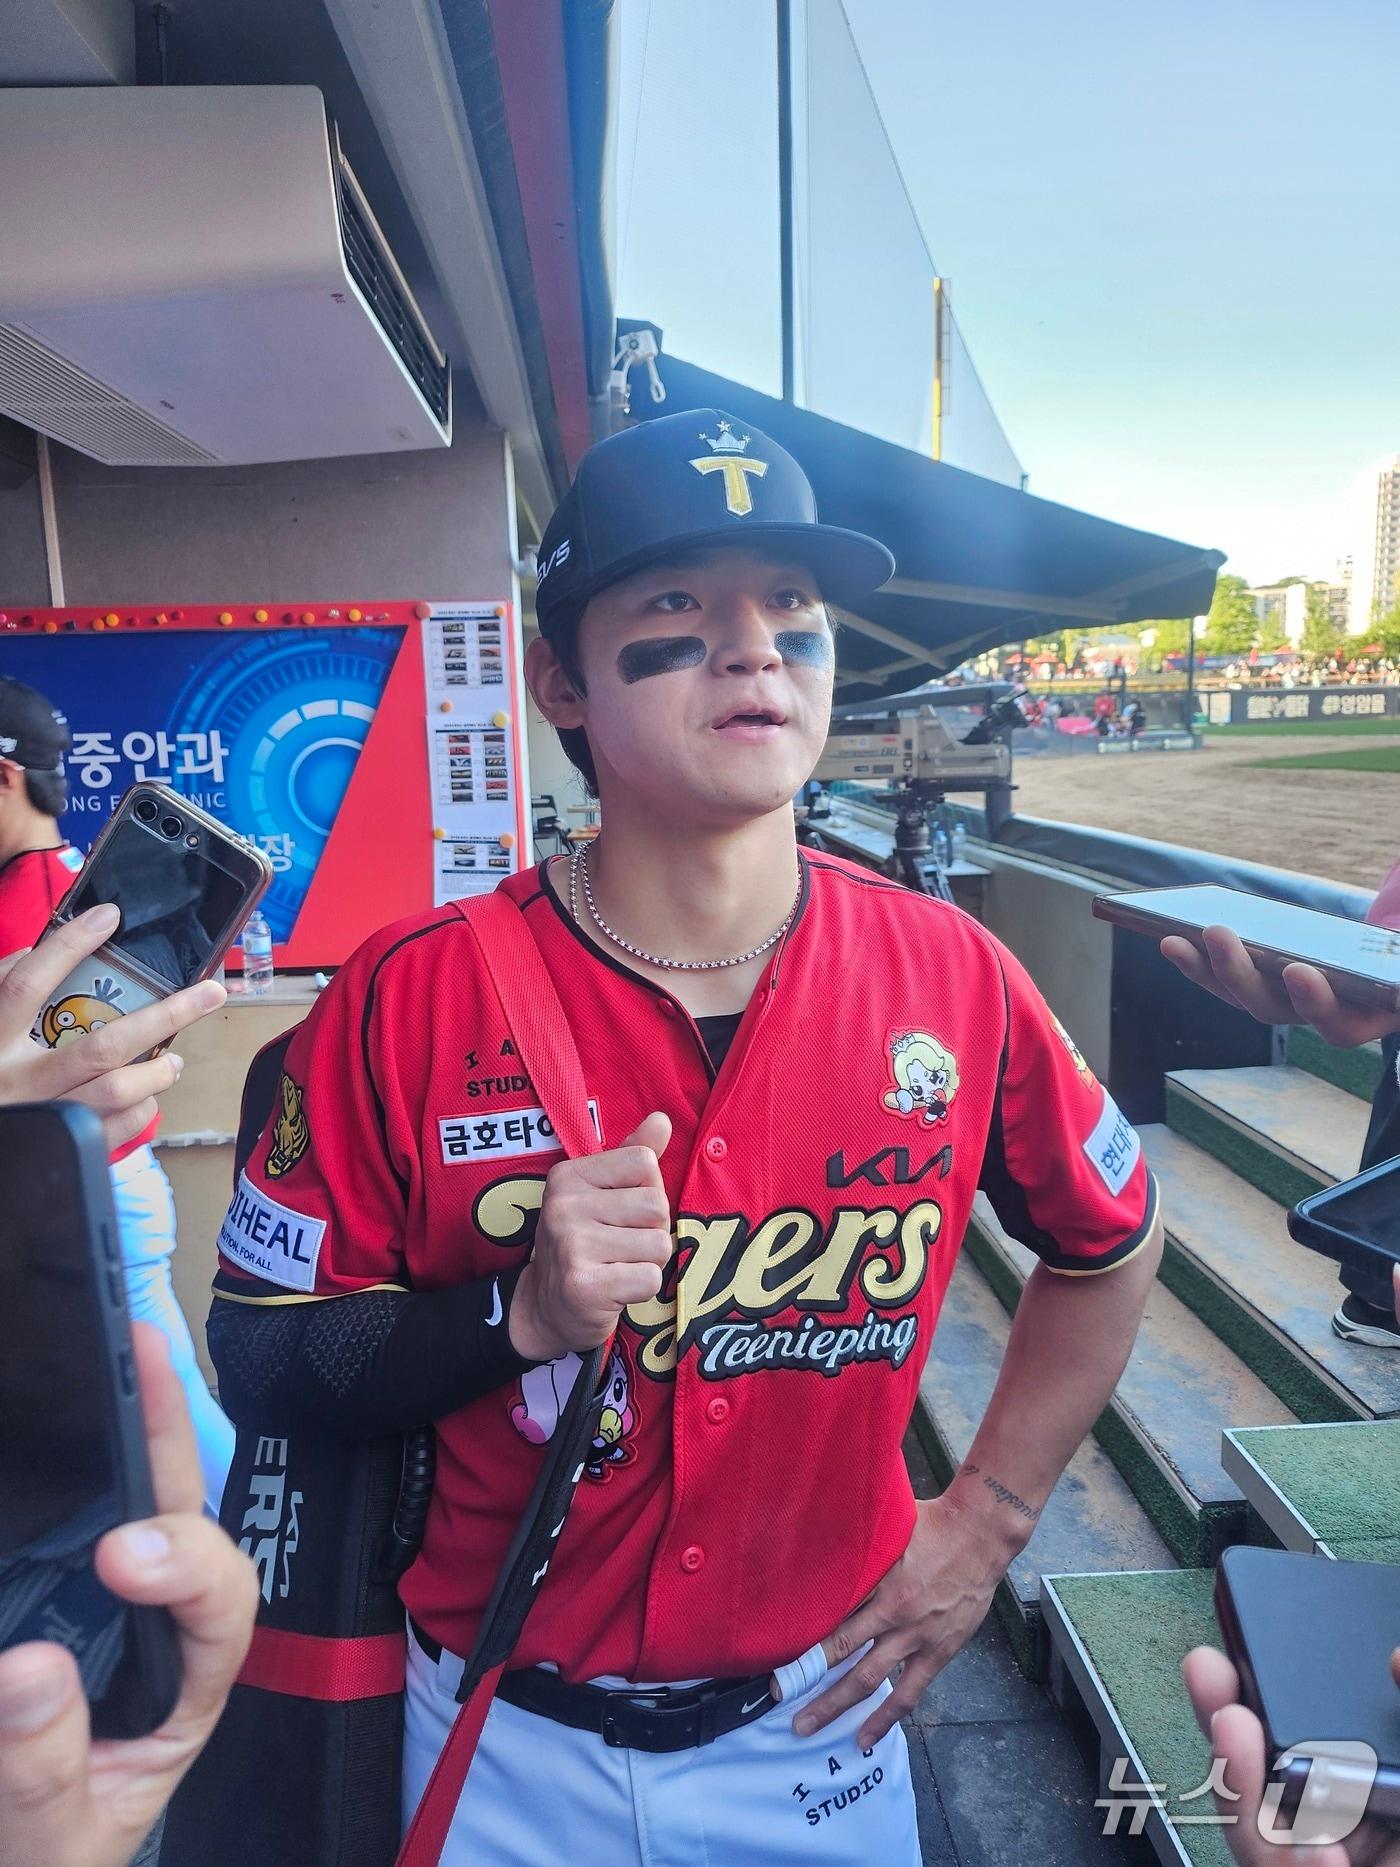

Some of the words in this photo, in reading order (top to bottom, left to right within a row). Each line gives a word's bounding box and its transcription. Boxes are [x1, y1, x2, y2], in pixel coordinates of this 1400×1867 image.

[60, 729, 229, 789] 중안과
[245, 832, 296, 873] 장
[467, 1075, 536, 1098] STUD
[826, 1144, 953, 1188] KIA
[240, 1247, 255, 1264] FOR
[255, 1256, 273, 1272] ALL
[472, 1176, 943, 1378] gers
[701, 1311, 917, 1373] Teenieping
[805, 1766, 884, 1827] STUDIO
